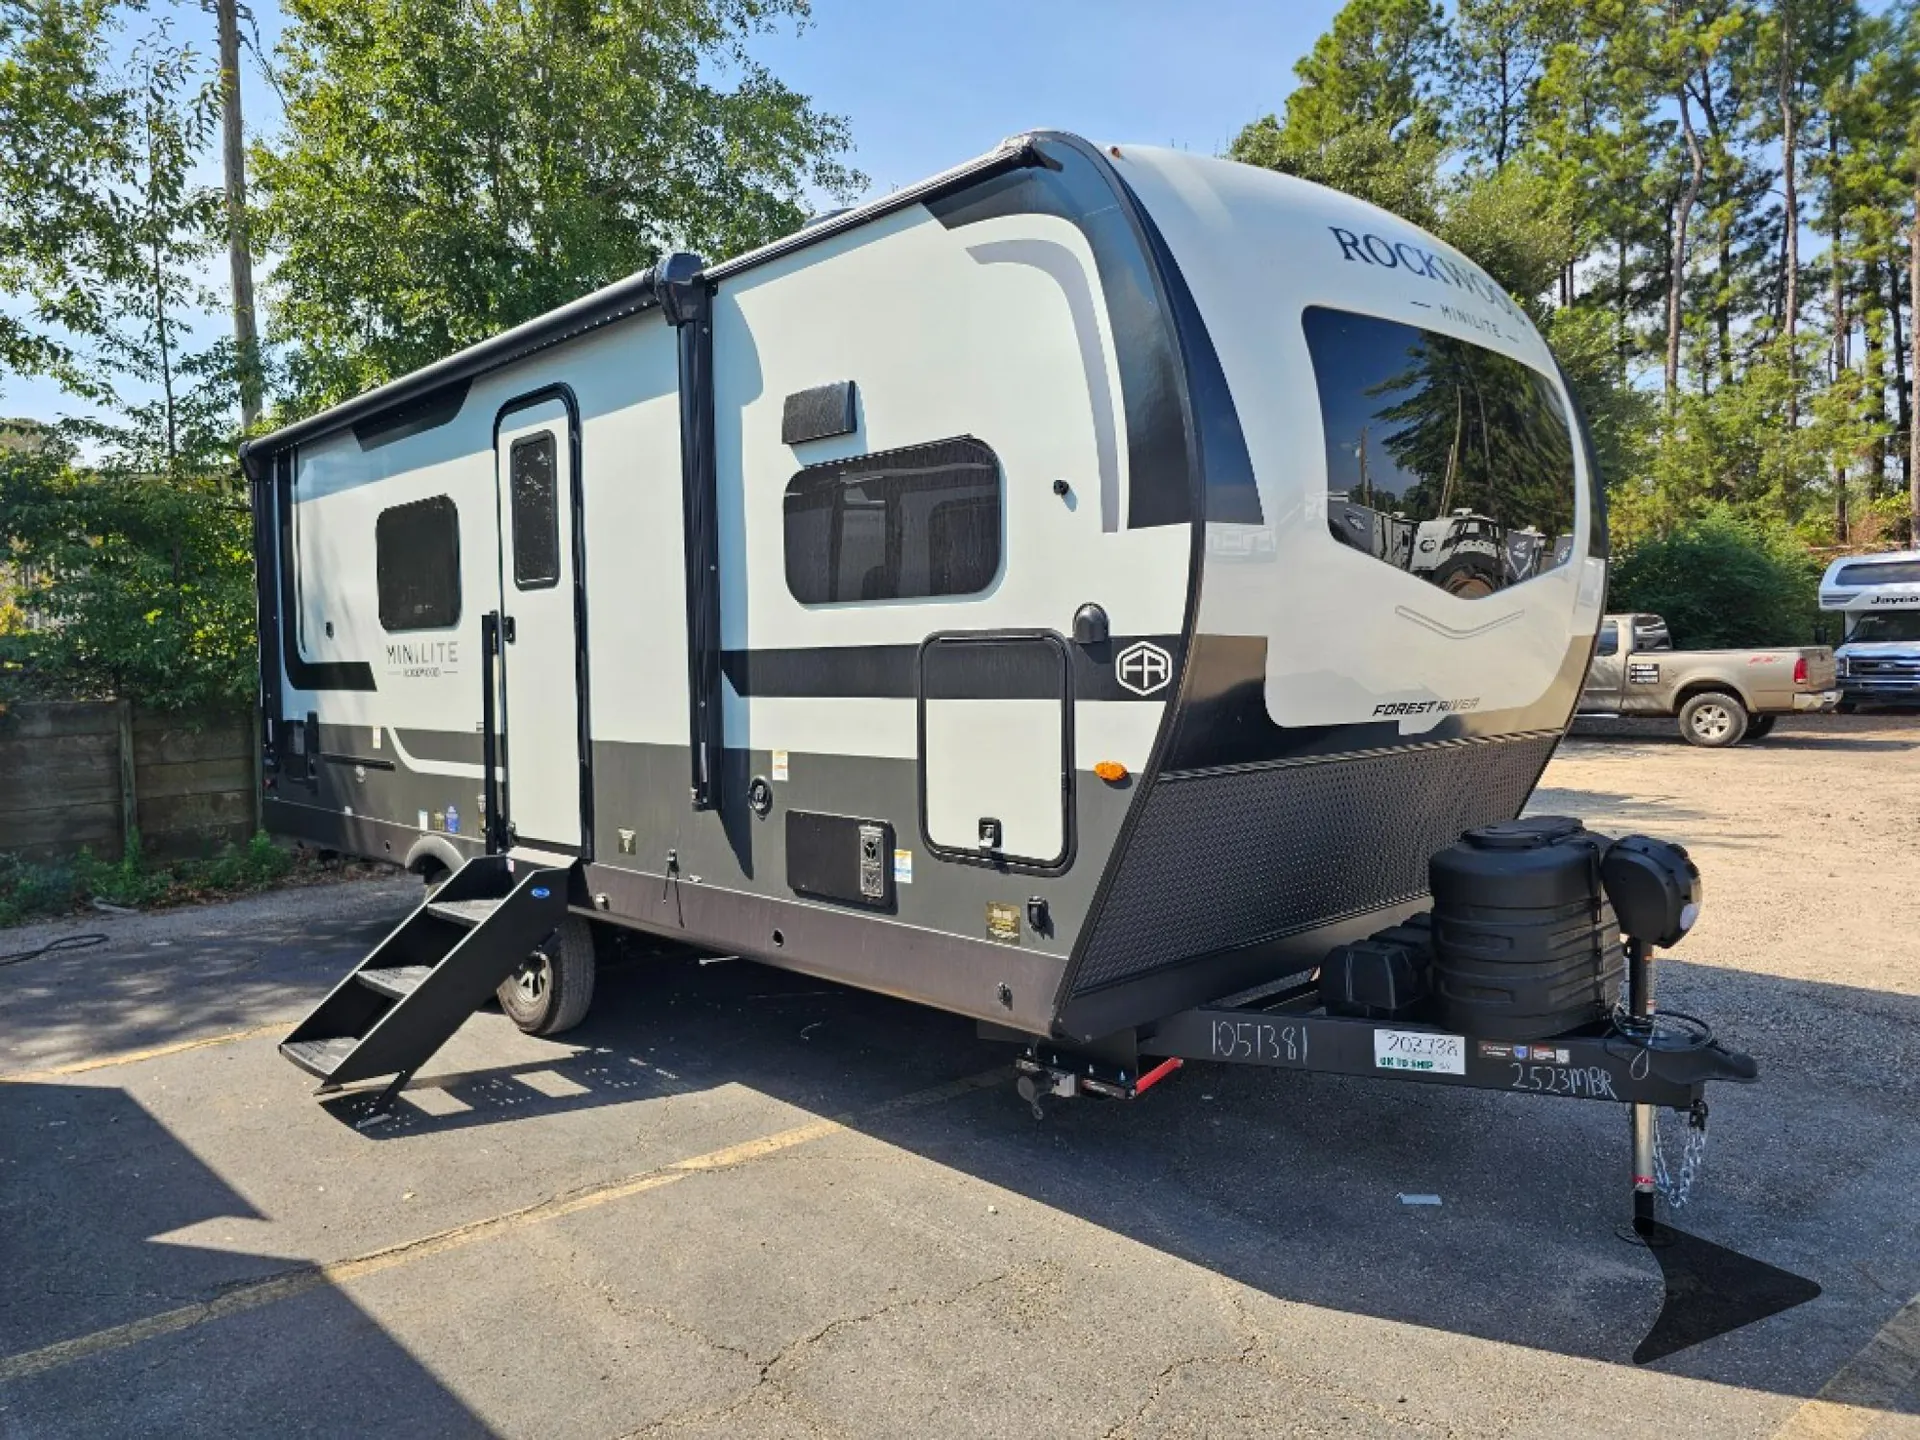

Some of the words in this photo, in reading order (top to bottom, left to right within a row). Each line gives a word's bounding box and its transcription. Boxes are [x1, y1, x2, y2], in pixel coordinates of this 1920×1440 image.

[1372, 700, 1437, 717] FOREST
[1436, 697, 1480, 713] RIVER
[1212, 1019, 1308, 1065] 1051381
[1510, 1062, 1618, 1101] 2523MBR
